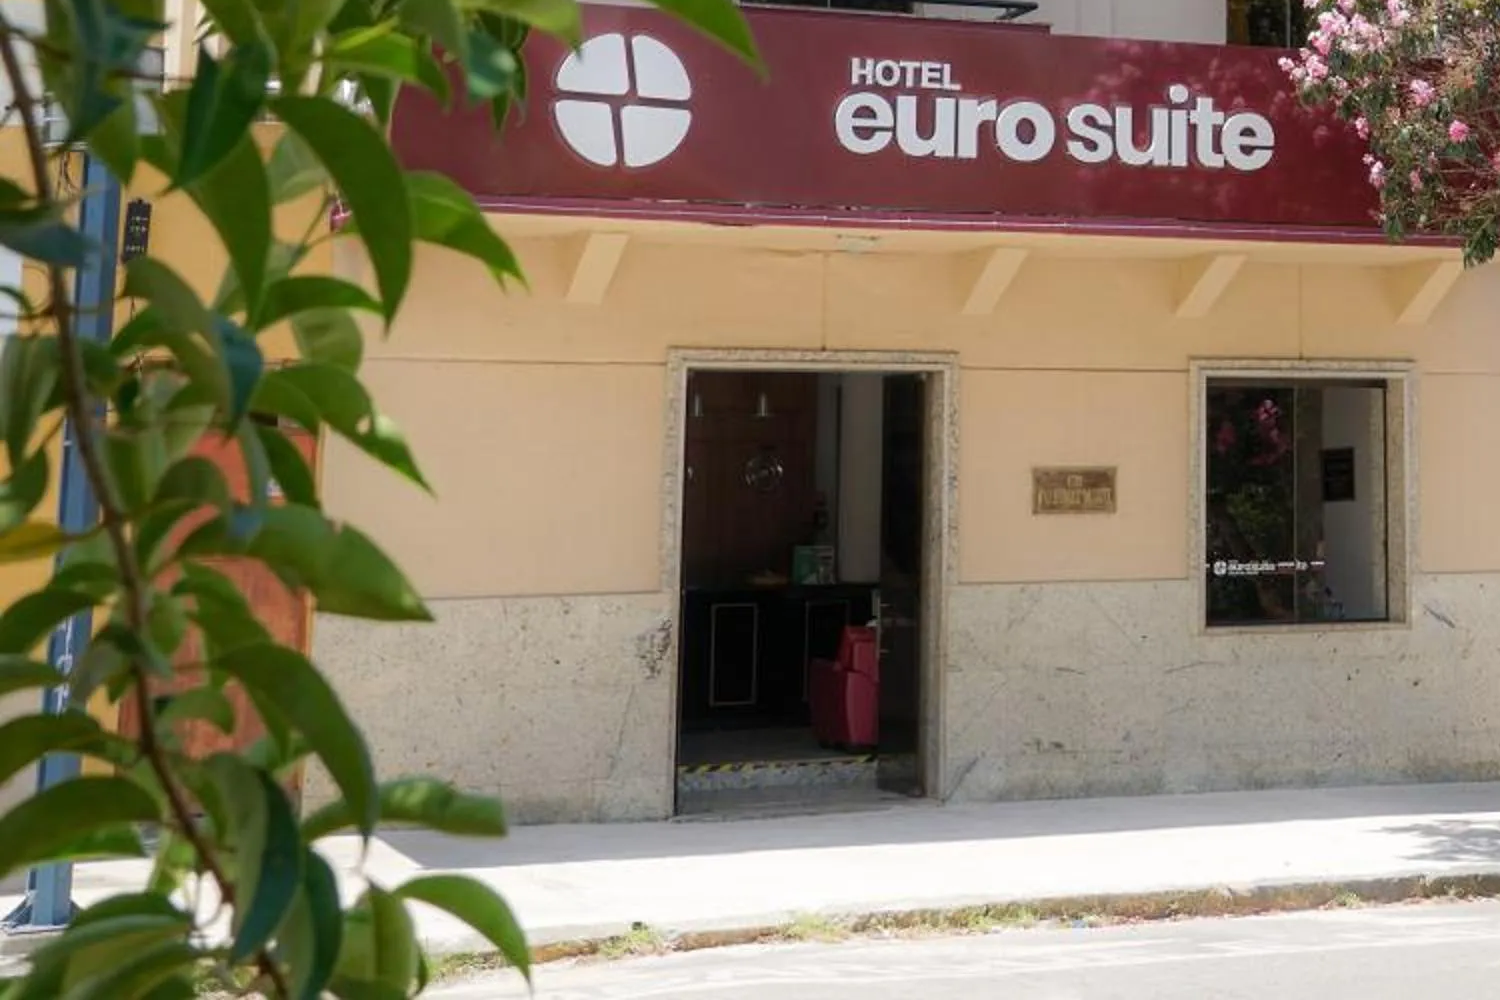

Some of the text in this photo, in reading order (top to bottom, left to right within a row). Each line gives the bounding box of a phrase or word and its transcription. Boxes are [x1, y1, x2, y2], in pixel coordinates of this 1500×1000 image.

[850, 57, 961, 91] HOTEL
[835, 84, 1275, 172] euro suite
